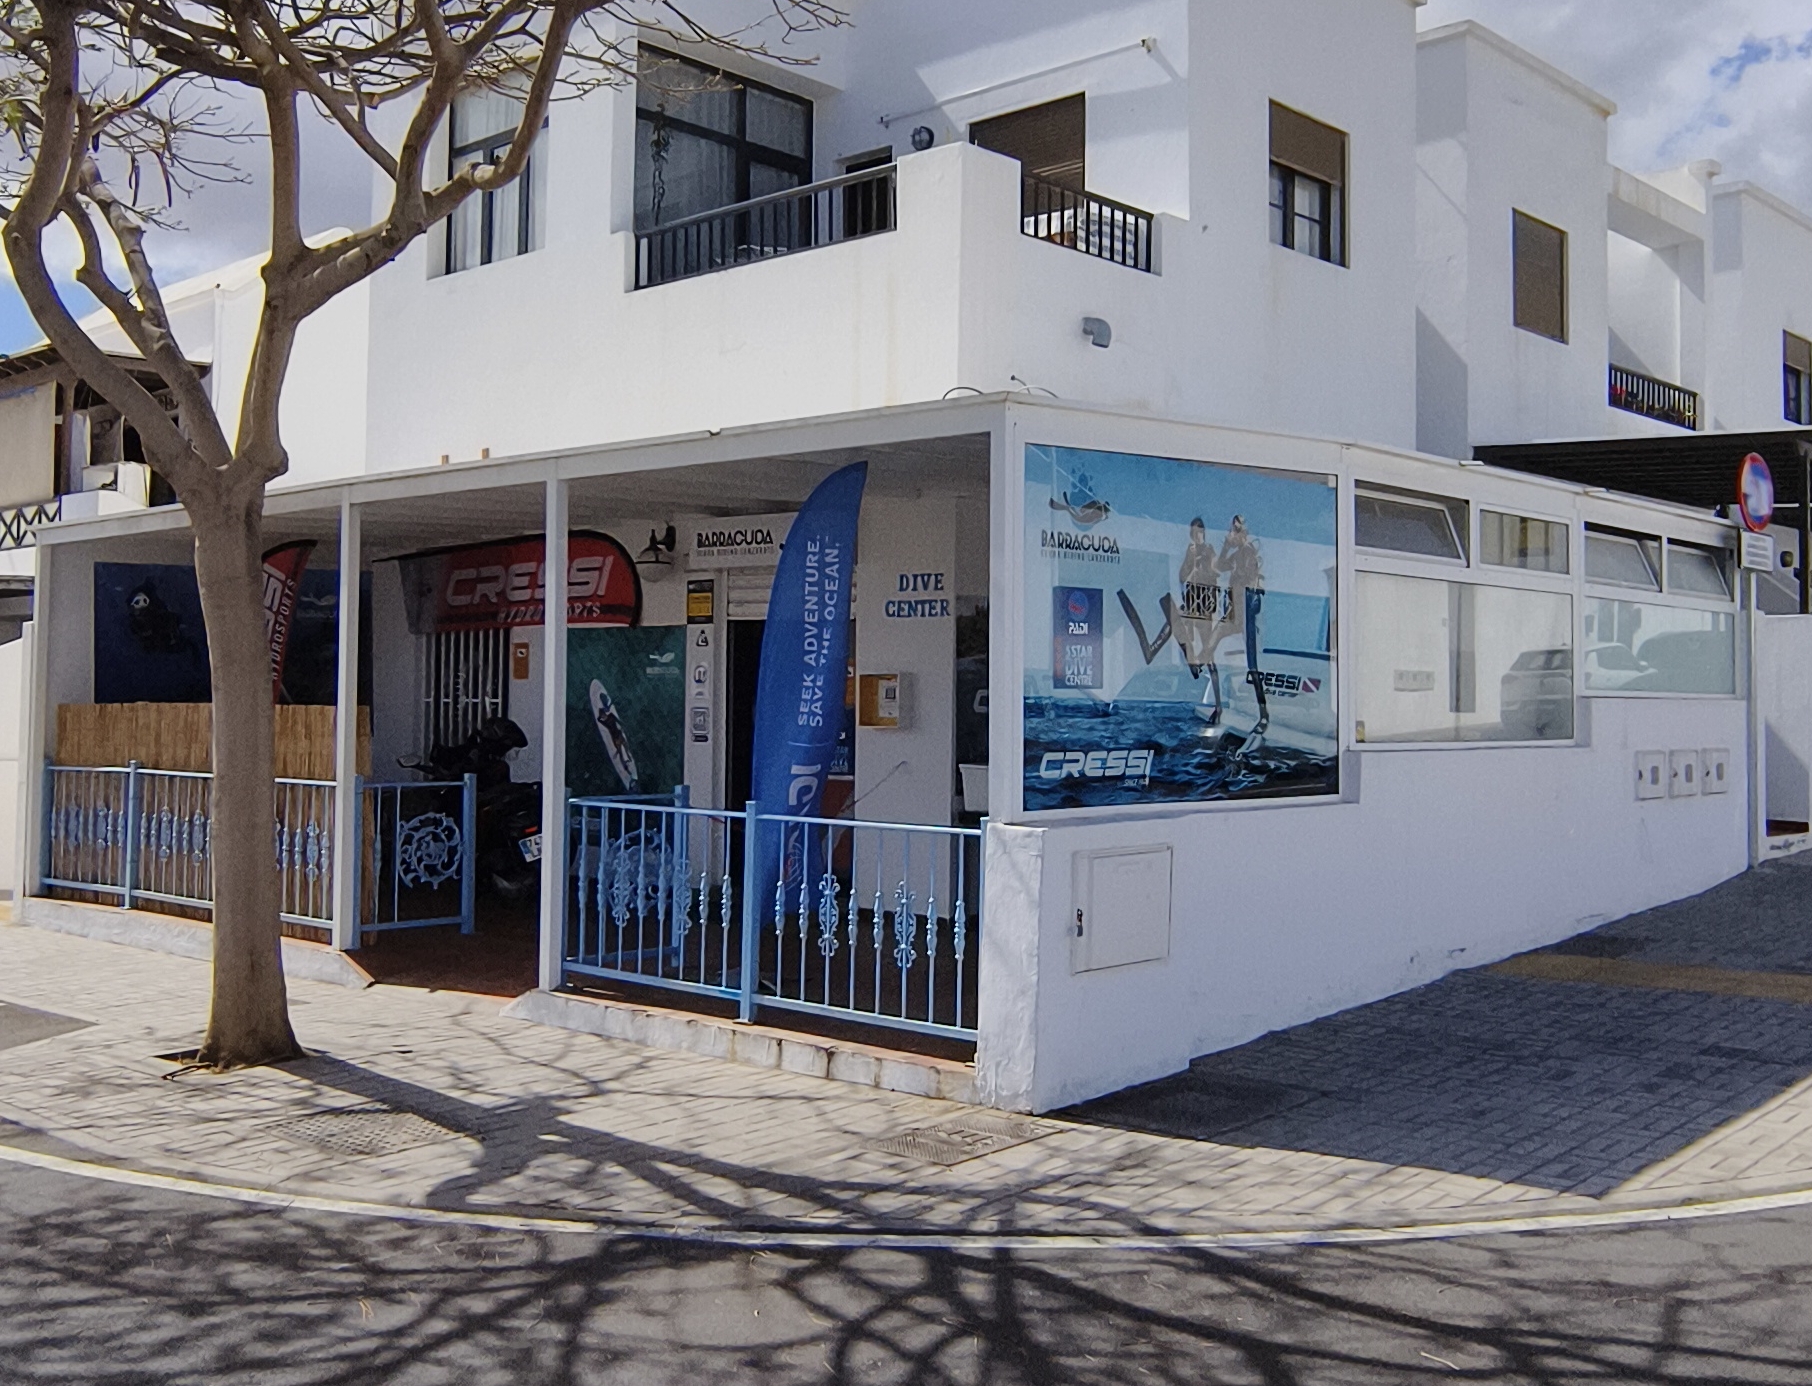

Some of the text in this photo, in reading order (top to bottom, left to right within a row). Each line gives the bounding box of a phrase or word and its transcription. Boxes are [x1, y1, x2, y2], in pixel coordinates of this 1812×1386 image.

[697, 529, 774, 548] BARRACUDA
[1041, 529, 1120, 554] BARRACUDA
[898, 572, 945, 592] DIVE
[885, 599, 951, 618] CENTER
[798, 535, 820, 726] SEEK ADVENTURE.
[1068, 622, 1089, 634] PADI
[1065, 658, 1093, 675] DIVE
[810, 675, 824, 727] SAVE
[819, 626, 833, 667] THE
[1065, 675, 1093, 686] CENTRE
[1040, 749, 1154, 779] CRESSI
